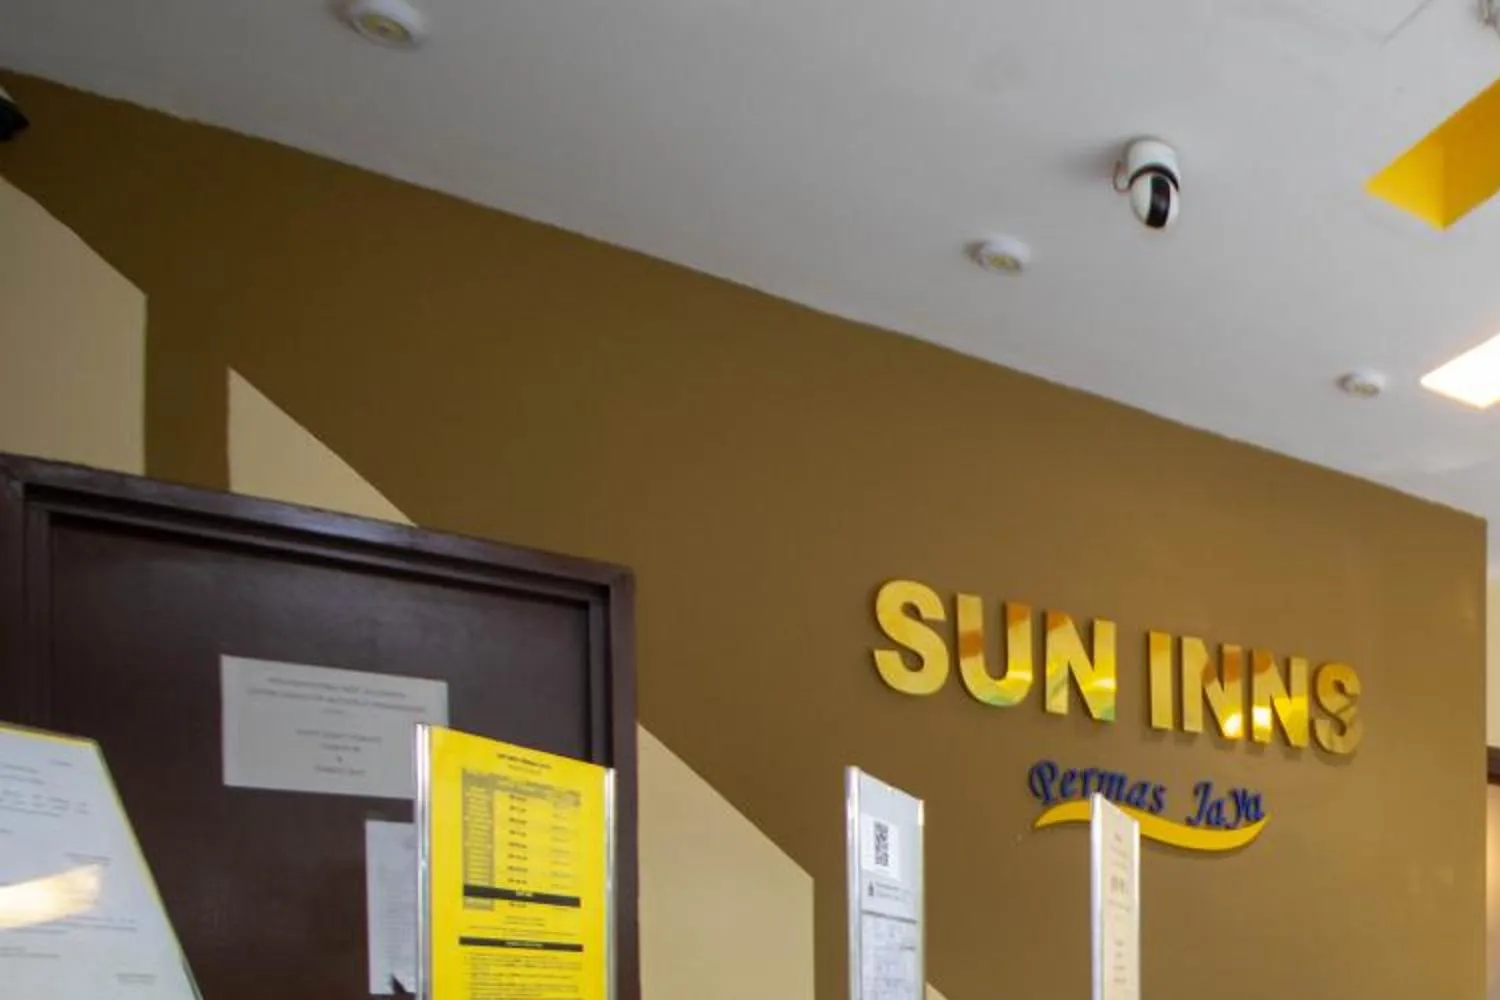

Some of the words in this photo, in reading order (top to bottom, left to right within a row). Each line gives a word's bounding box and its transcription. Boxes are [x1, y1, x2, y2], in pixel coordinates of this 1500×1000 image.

[873, 579, 1117, 723] SUN
[1147, 630, 1363, 754] INNS
[1028, 759, 1167, 814] Permas
